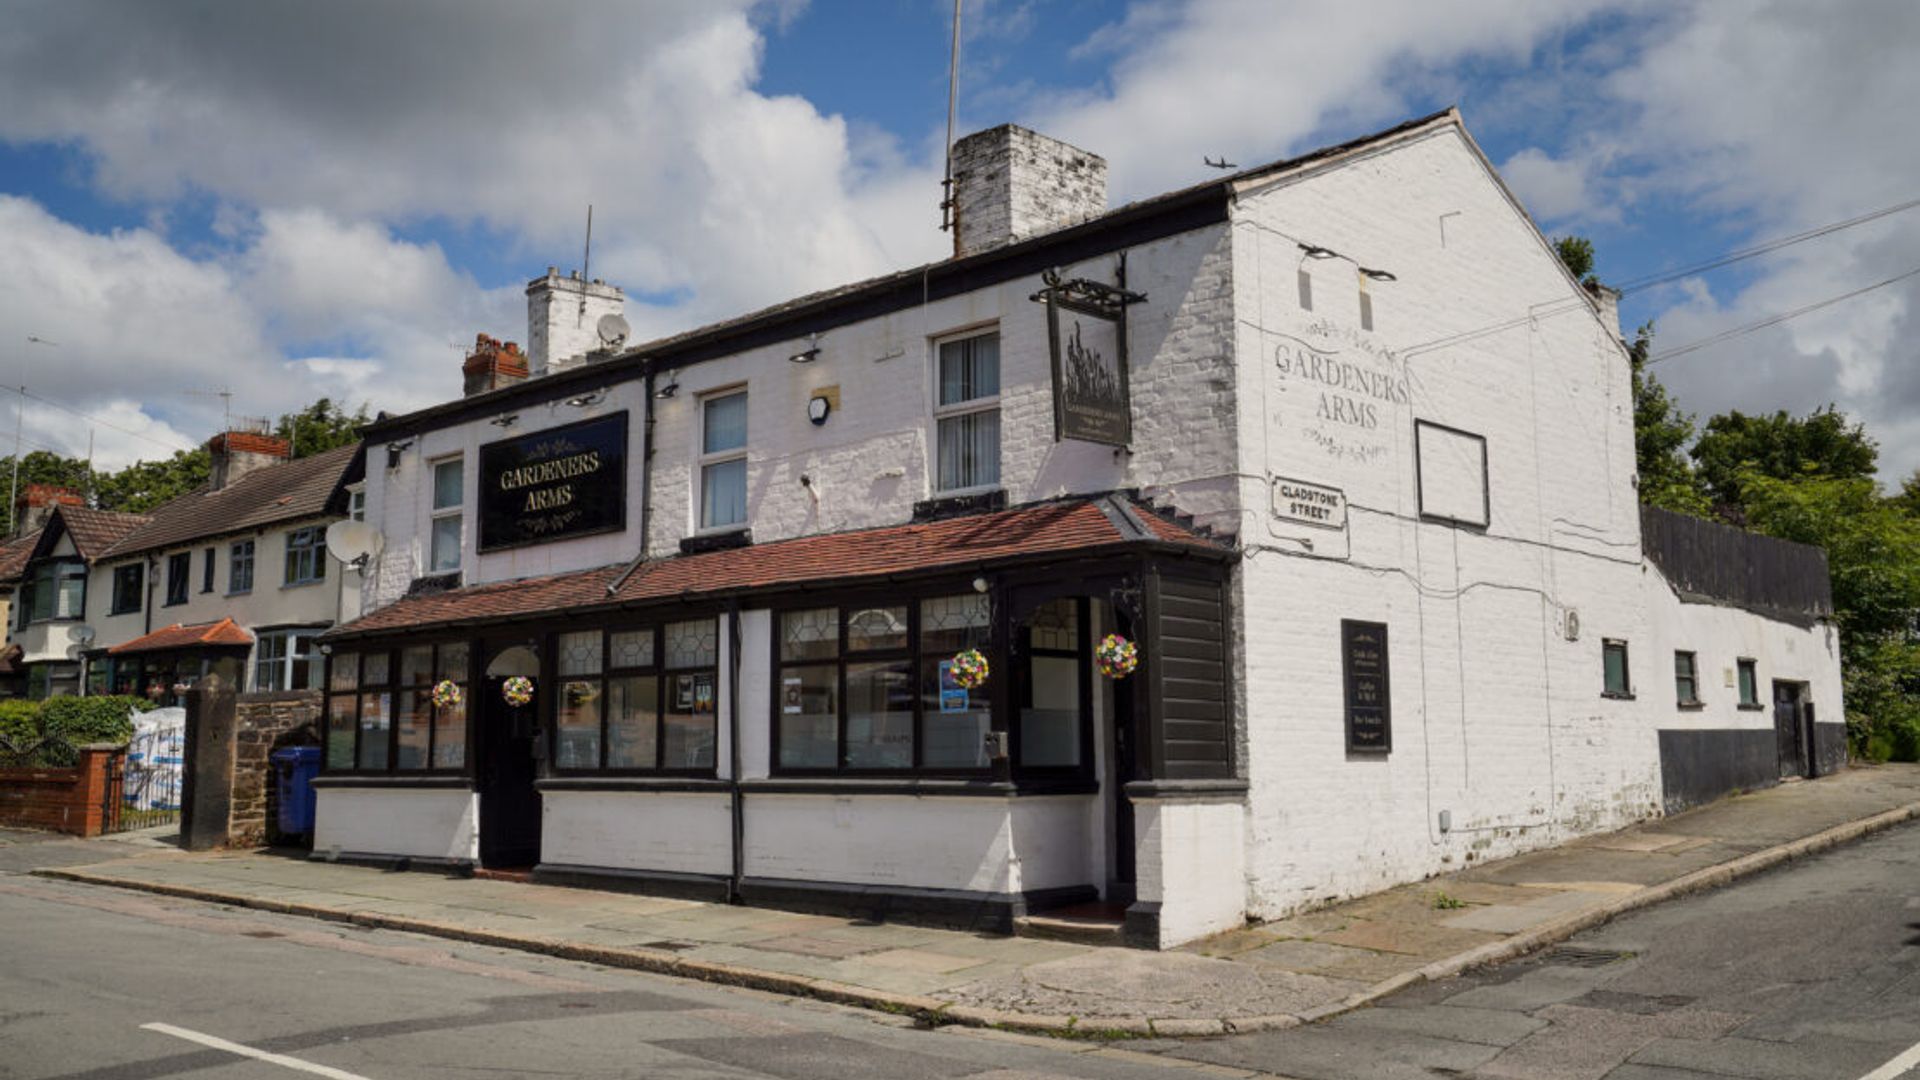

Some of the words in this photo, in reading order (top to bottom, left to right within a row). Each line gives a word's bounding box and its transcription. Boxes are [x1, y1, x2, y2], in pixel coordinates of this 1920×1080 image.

[1275, 345, 1408, 404] GARDENERS
[1316, 393, 1377, 429] ARMS
[501, 452, 599, 490] GARDENERS
[525, 485, 572, 511] ARMS
[1281, 485, 1338, 507] GLADSTONE
[1291, 503, 1330, 519] STREET
